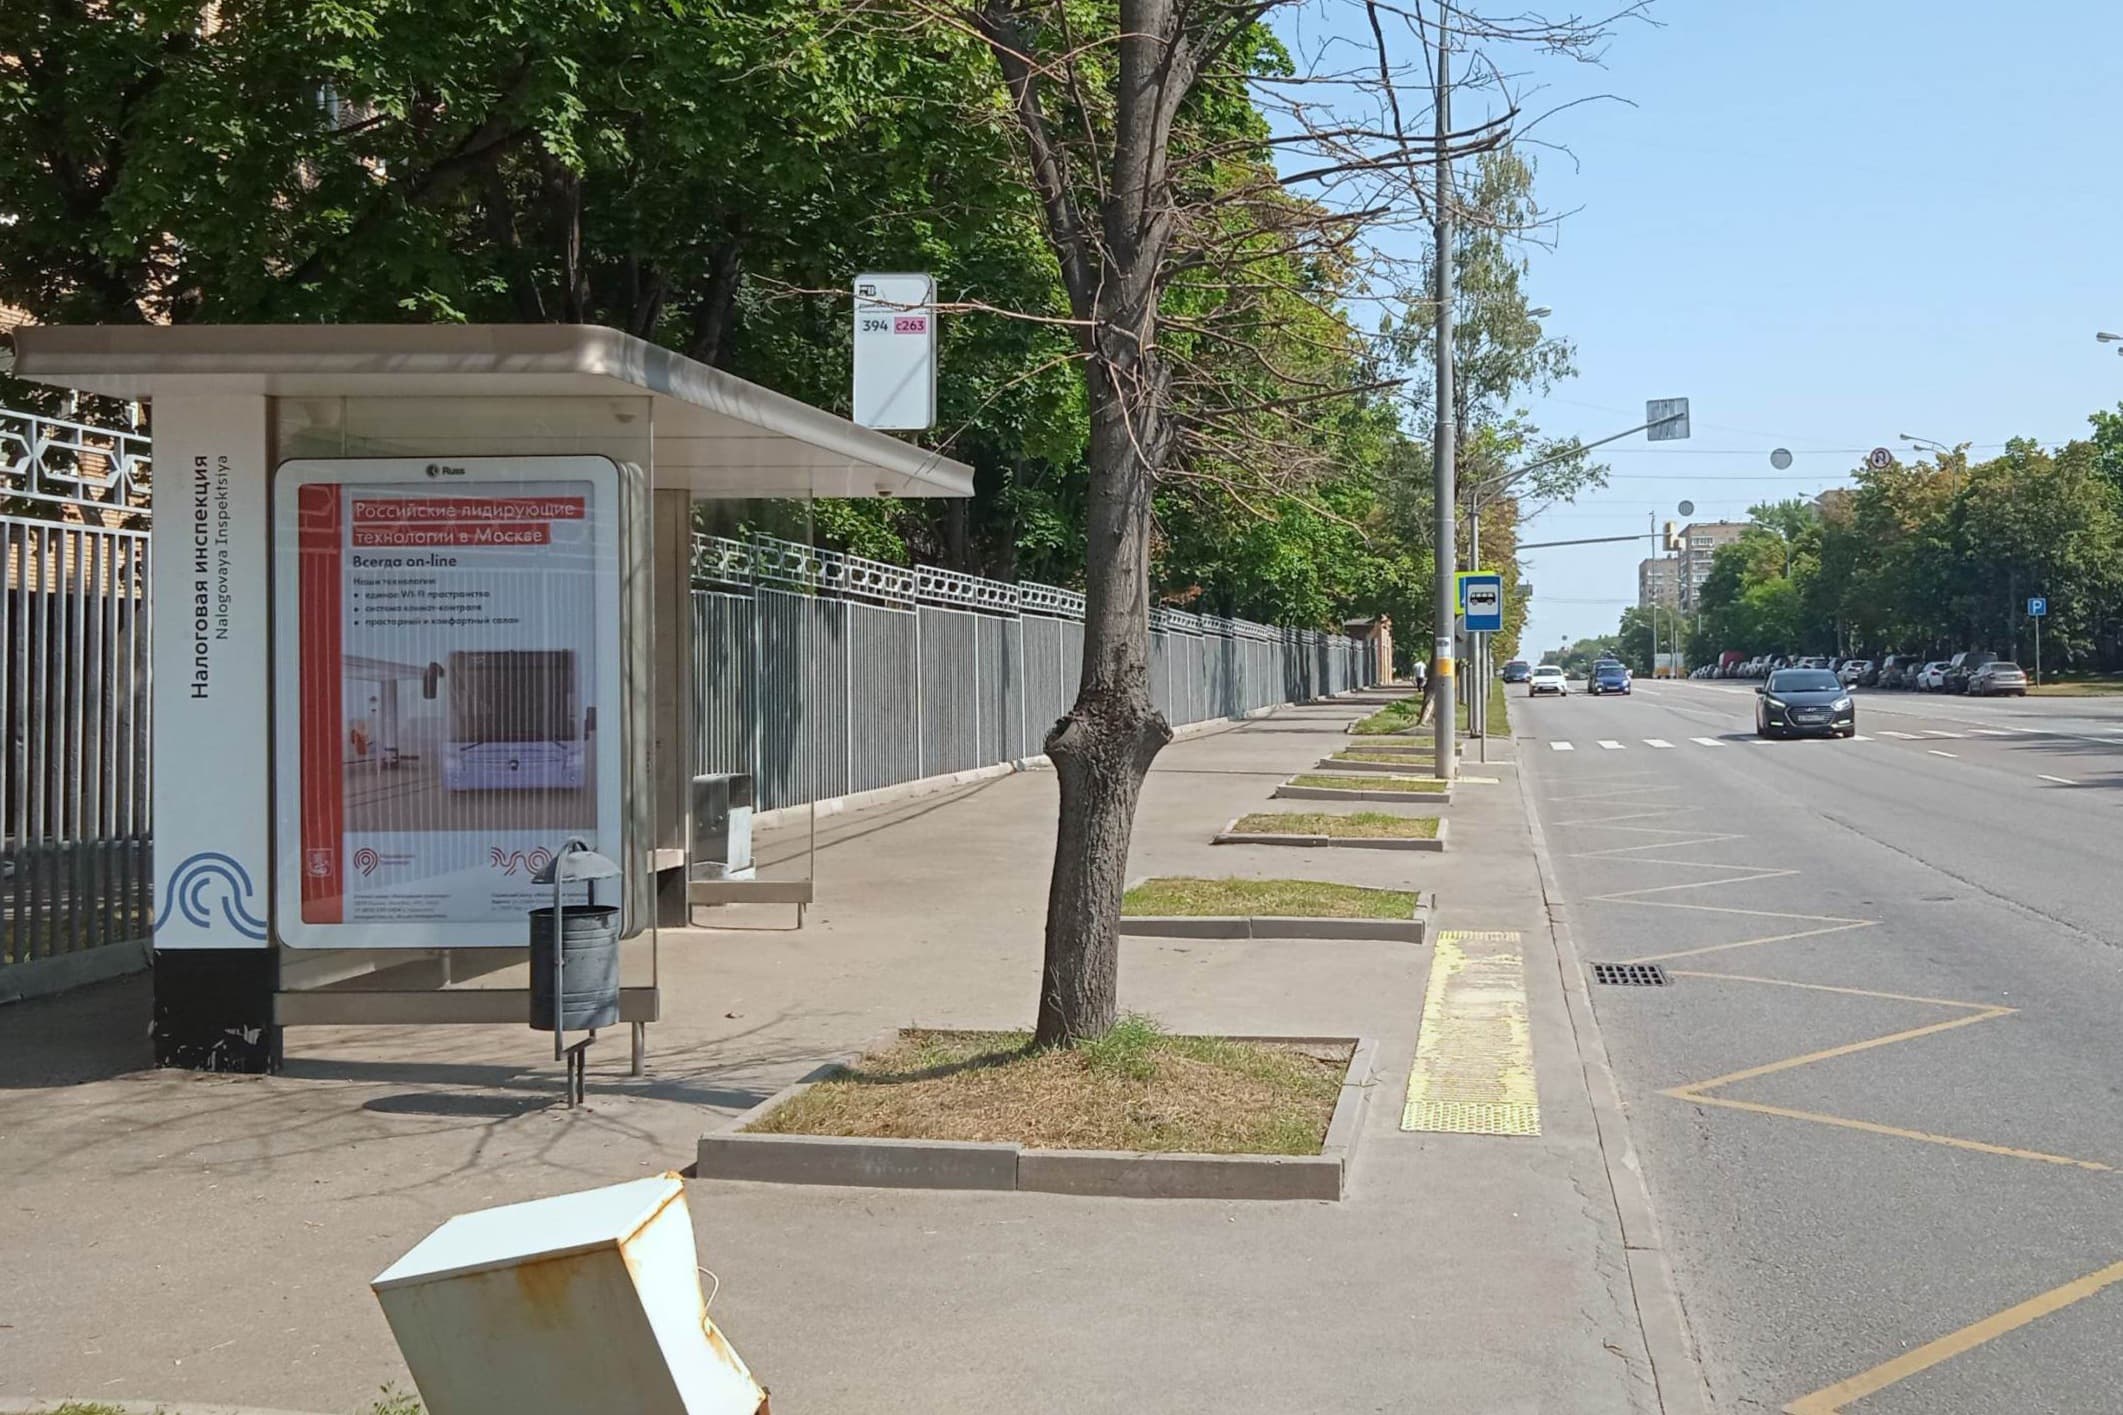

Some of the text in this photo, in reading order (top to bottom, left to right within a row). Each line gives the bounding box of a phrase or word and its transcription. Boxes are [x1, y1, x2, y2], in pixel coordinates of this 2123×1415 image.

[863, 320, 925, 332] 394 с263
[442, 466, 465, 475] Russ
[355, 502, 575, 520] Российские лидирующие
[356, 527, 543, 545] технологии в Москве
[214, 455, 231, 640] Nalogovaya Inspektsiya
[353, 553, 457, 568] Всегда on-line
[191, 455, 210, 699] Налоговая инспекция
[2033, 600, 2042, 614] P
